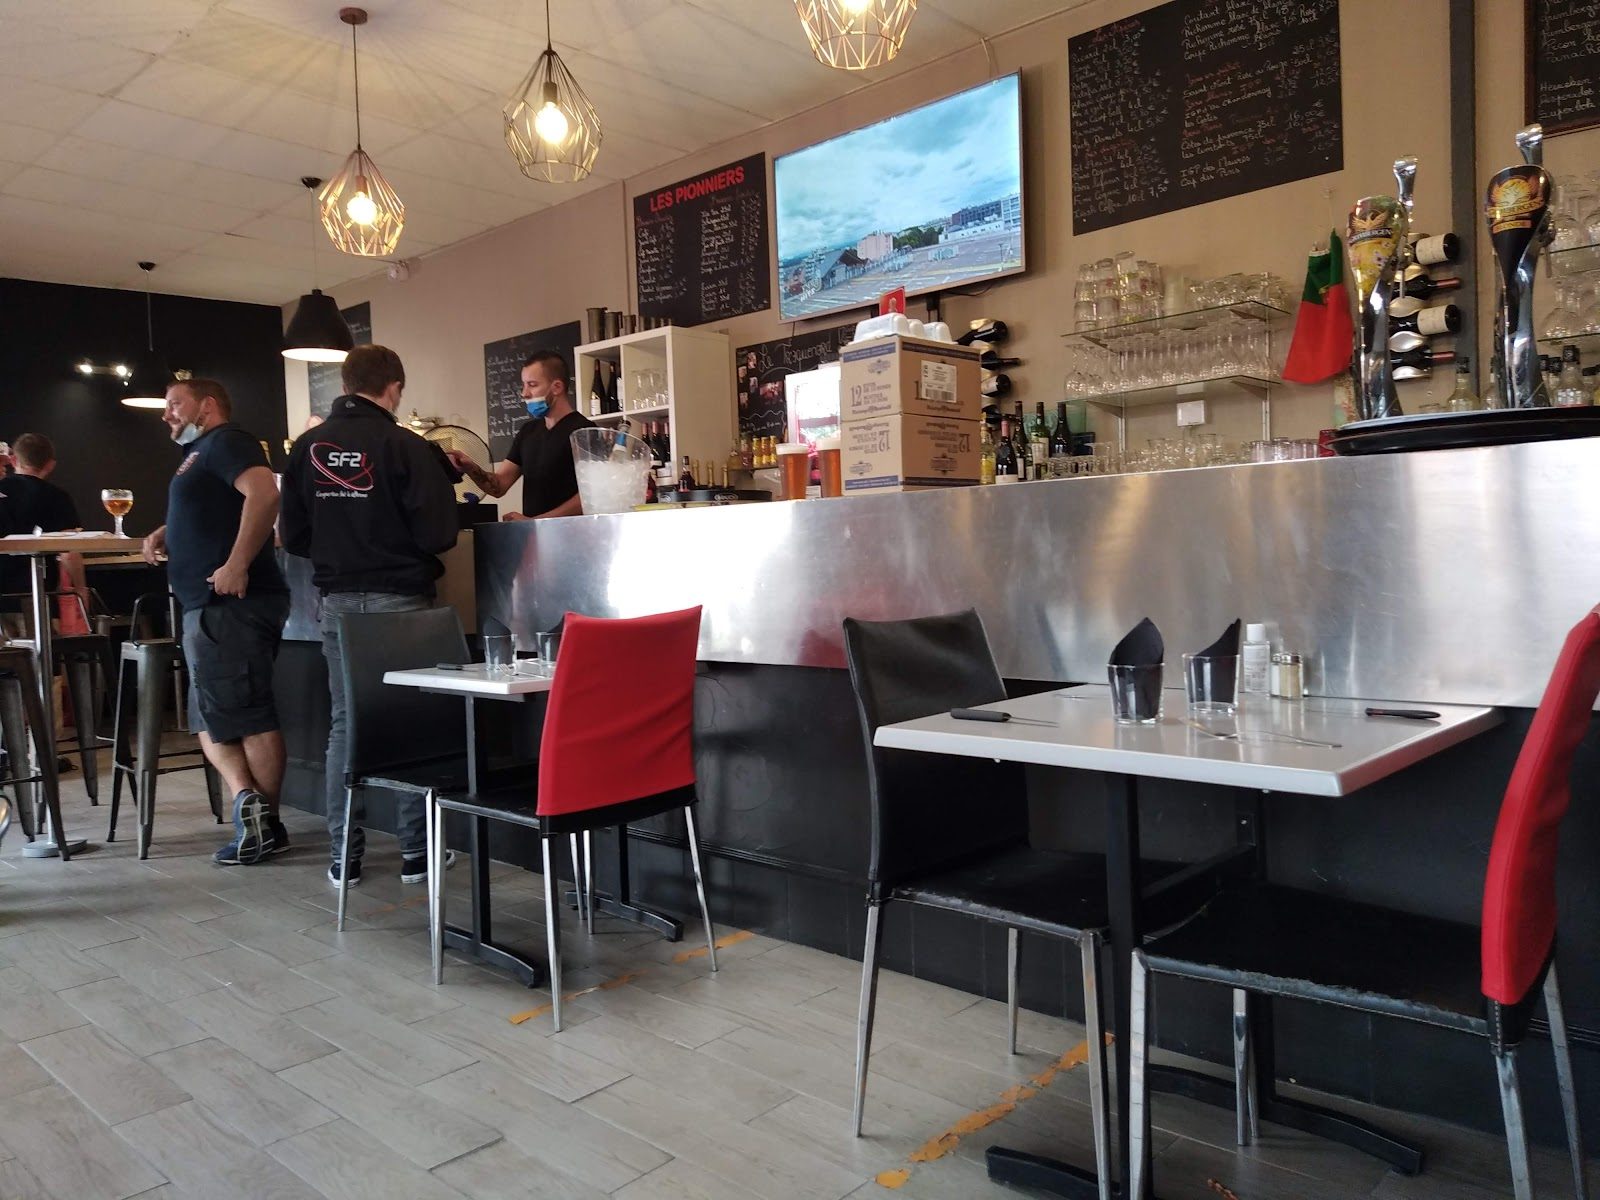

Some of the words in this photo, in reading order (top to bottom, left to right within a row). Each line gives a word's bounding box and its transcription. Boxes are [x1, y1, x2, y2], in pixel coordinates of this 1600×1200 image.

[650, 190, 673, 212] LES
[676, 166, 744, 204] PIONNIERS
[851, 384, 862, 407] 12
